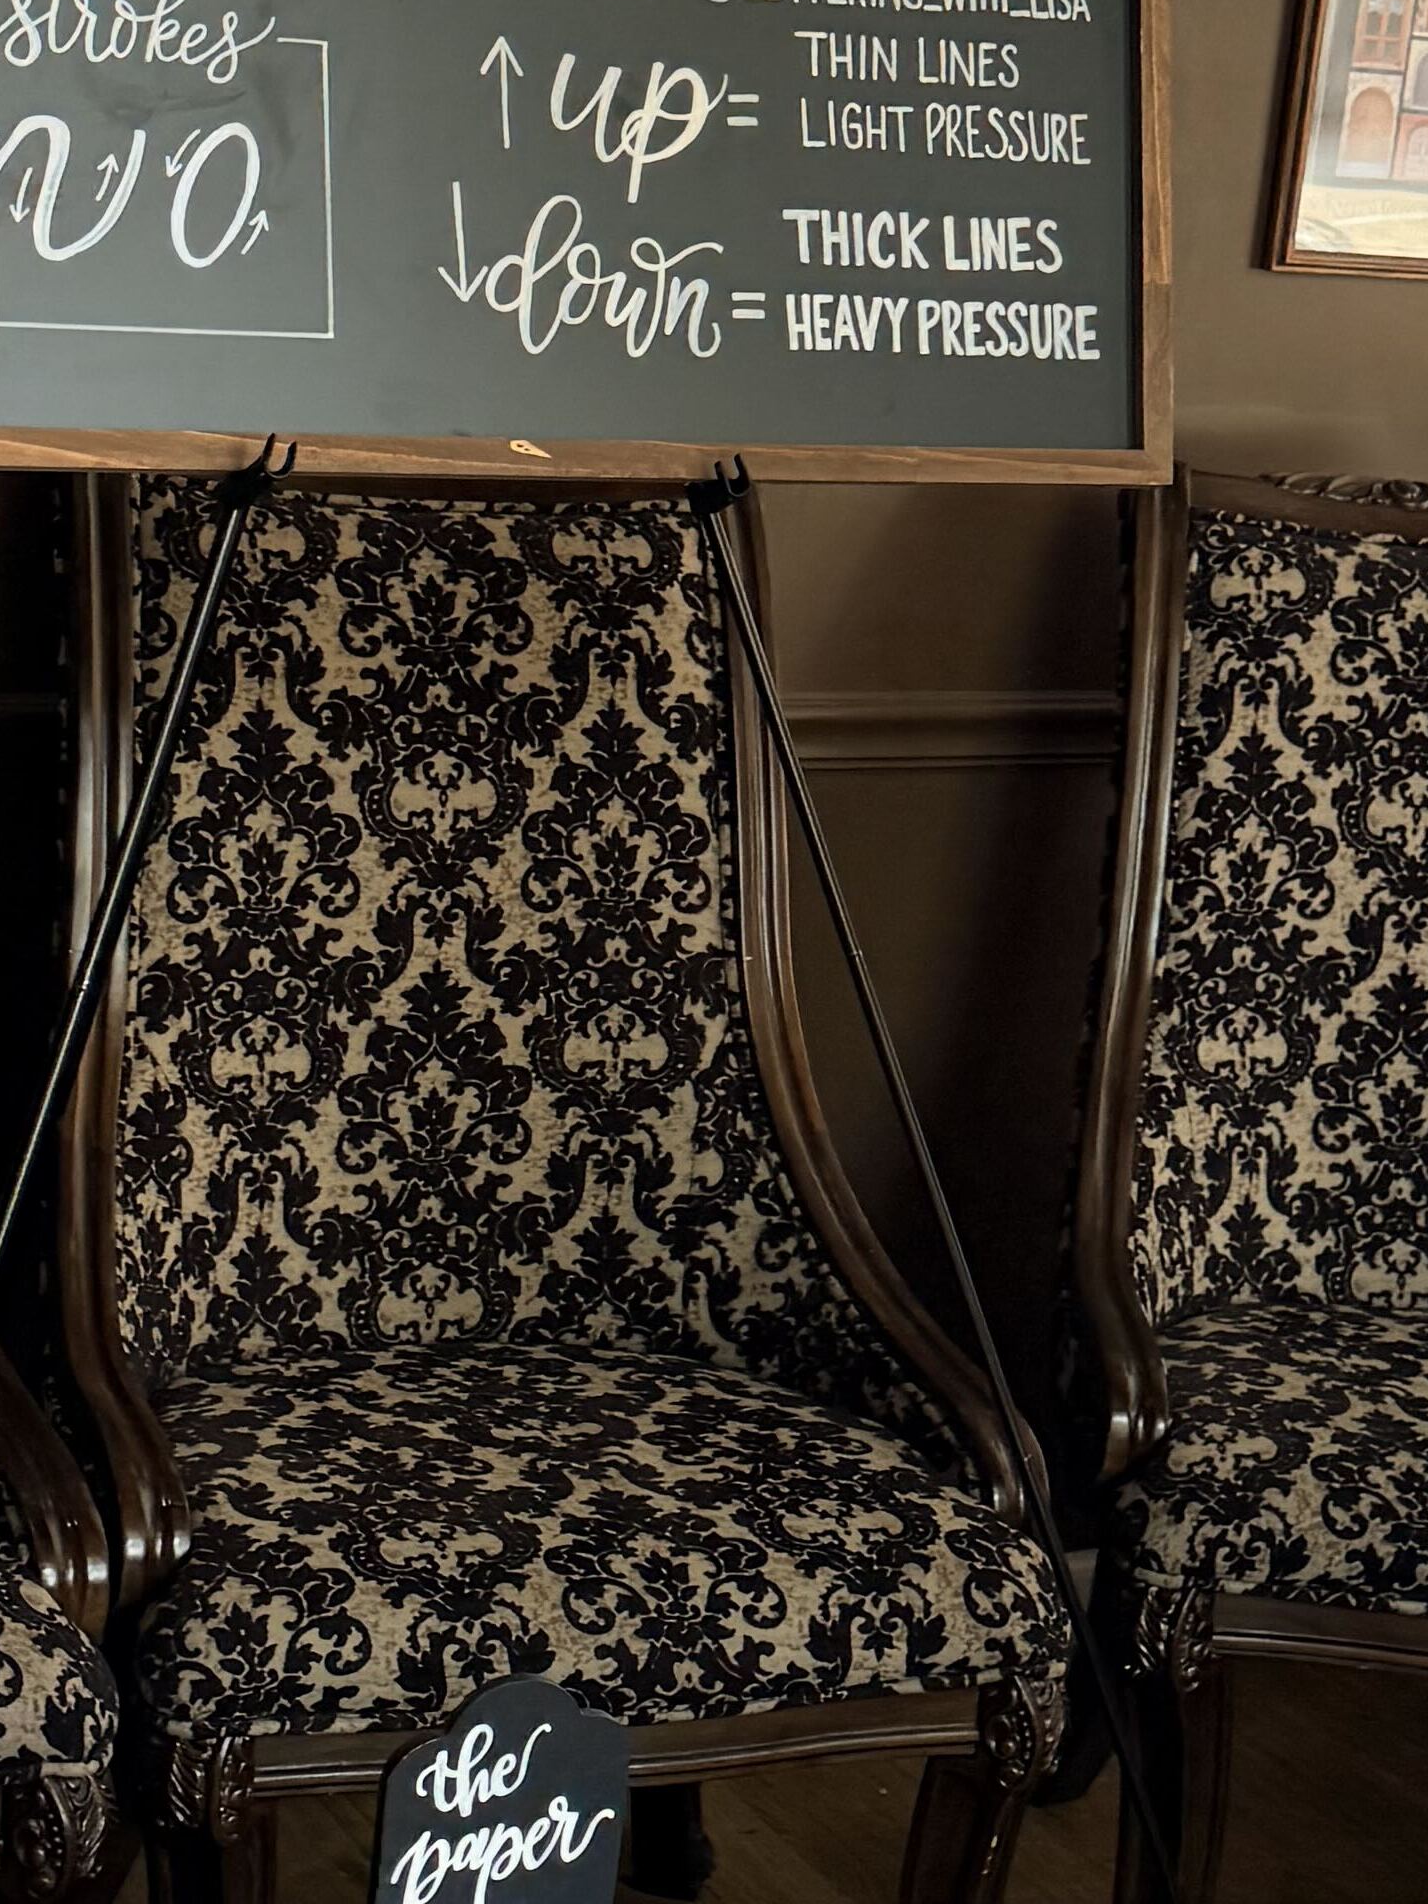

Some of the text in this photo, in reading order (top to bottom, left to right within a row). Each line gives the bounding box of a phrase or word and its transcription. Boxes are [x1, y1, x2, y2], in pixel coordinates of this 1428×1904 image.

[794, 29, 1021, 90] THIN LINES
[800, 97, 1093, 167] LIGHT PRESSURE
[781, 207, 1064, 275] THICK LINES
[785, 292, 1102, 362] HEAVY PRESSURE
[414, 1722, 553, 1818] the
